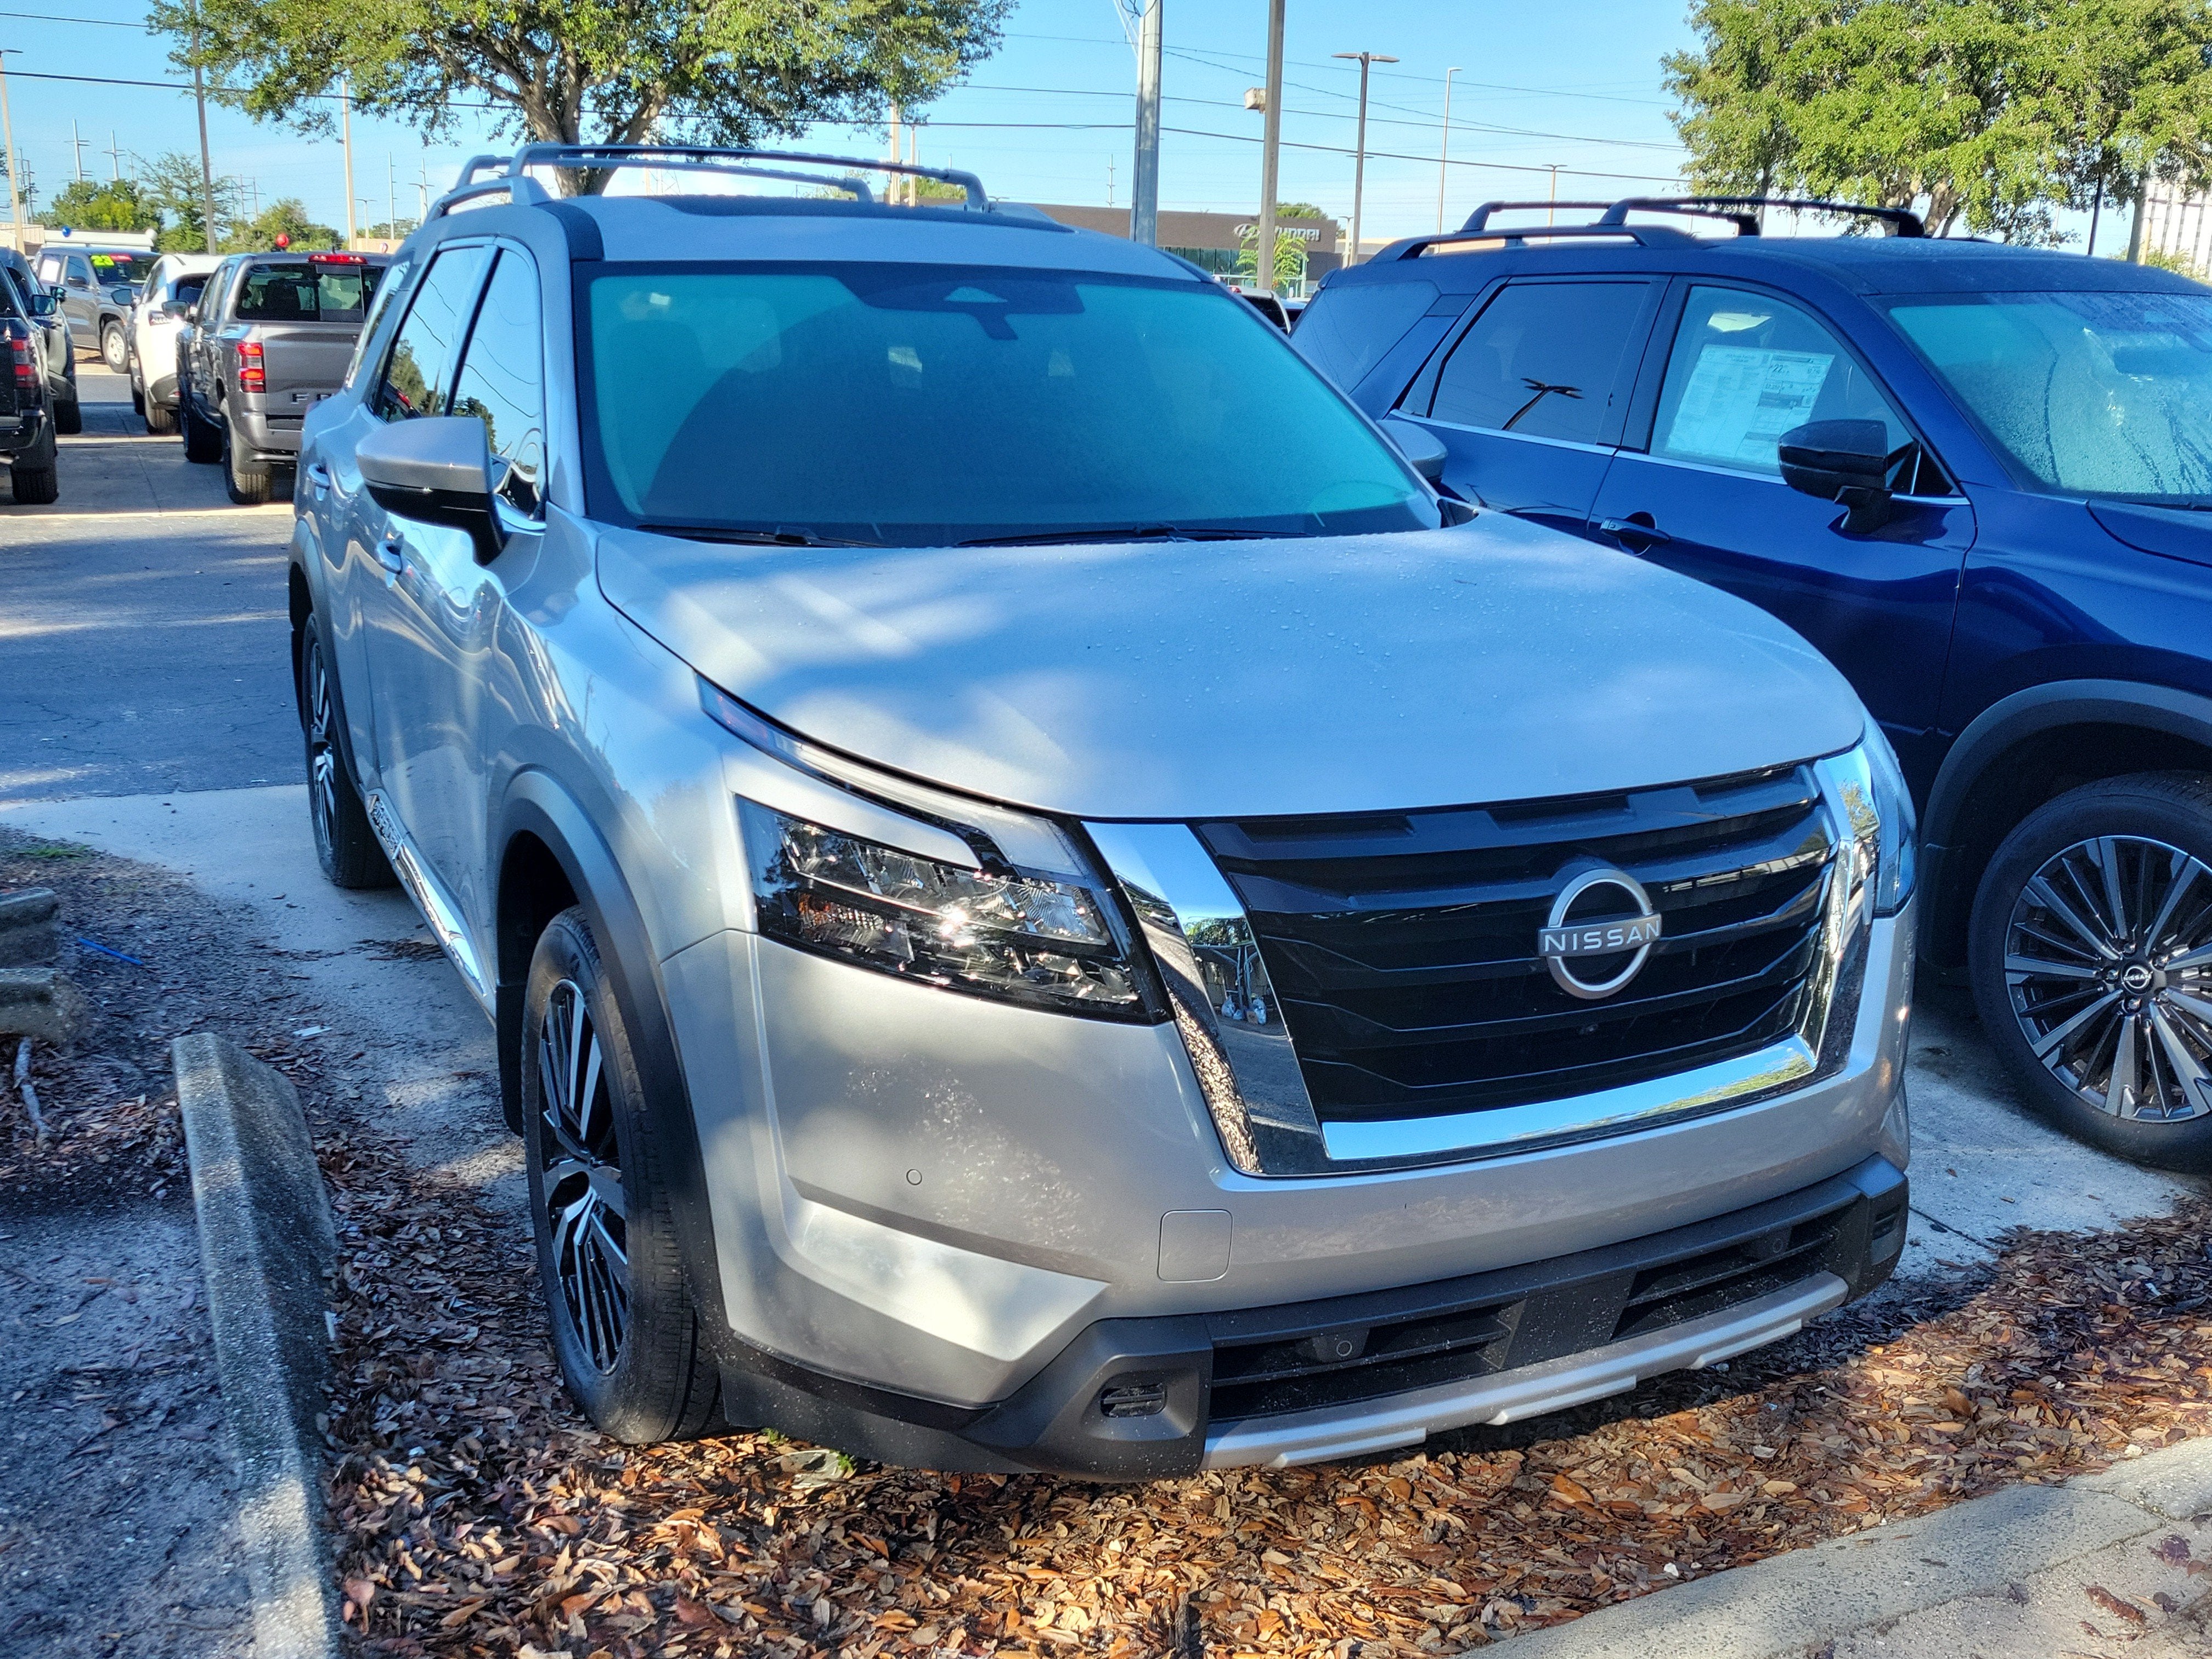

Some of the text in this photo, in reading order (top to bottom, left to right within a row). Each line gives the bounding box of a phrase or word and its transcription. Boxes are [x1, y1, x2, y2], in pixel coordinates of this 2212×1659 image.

[1274, 225, 1320, 241] UNDAI
[1544, 920, 1659, 952] NISSAN
[2123, 972, 2152, 981] NISSAN
